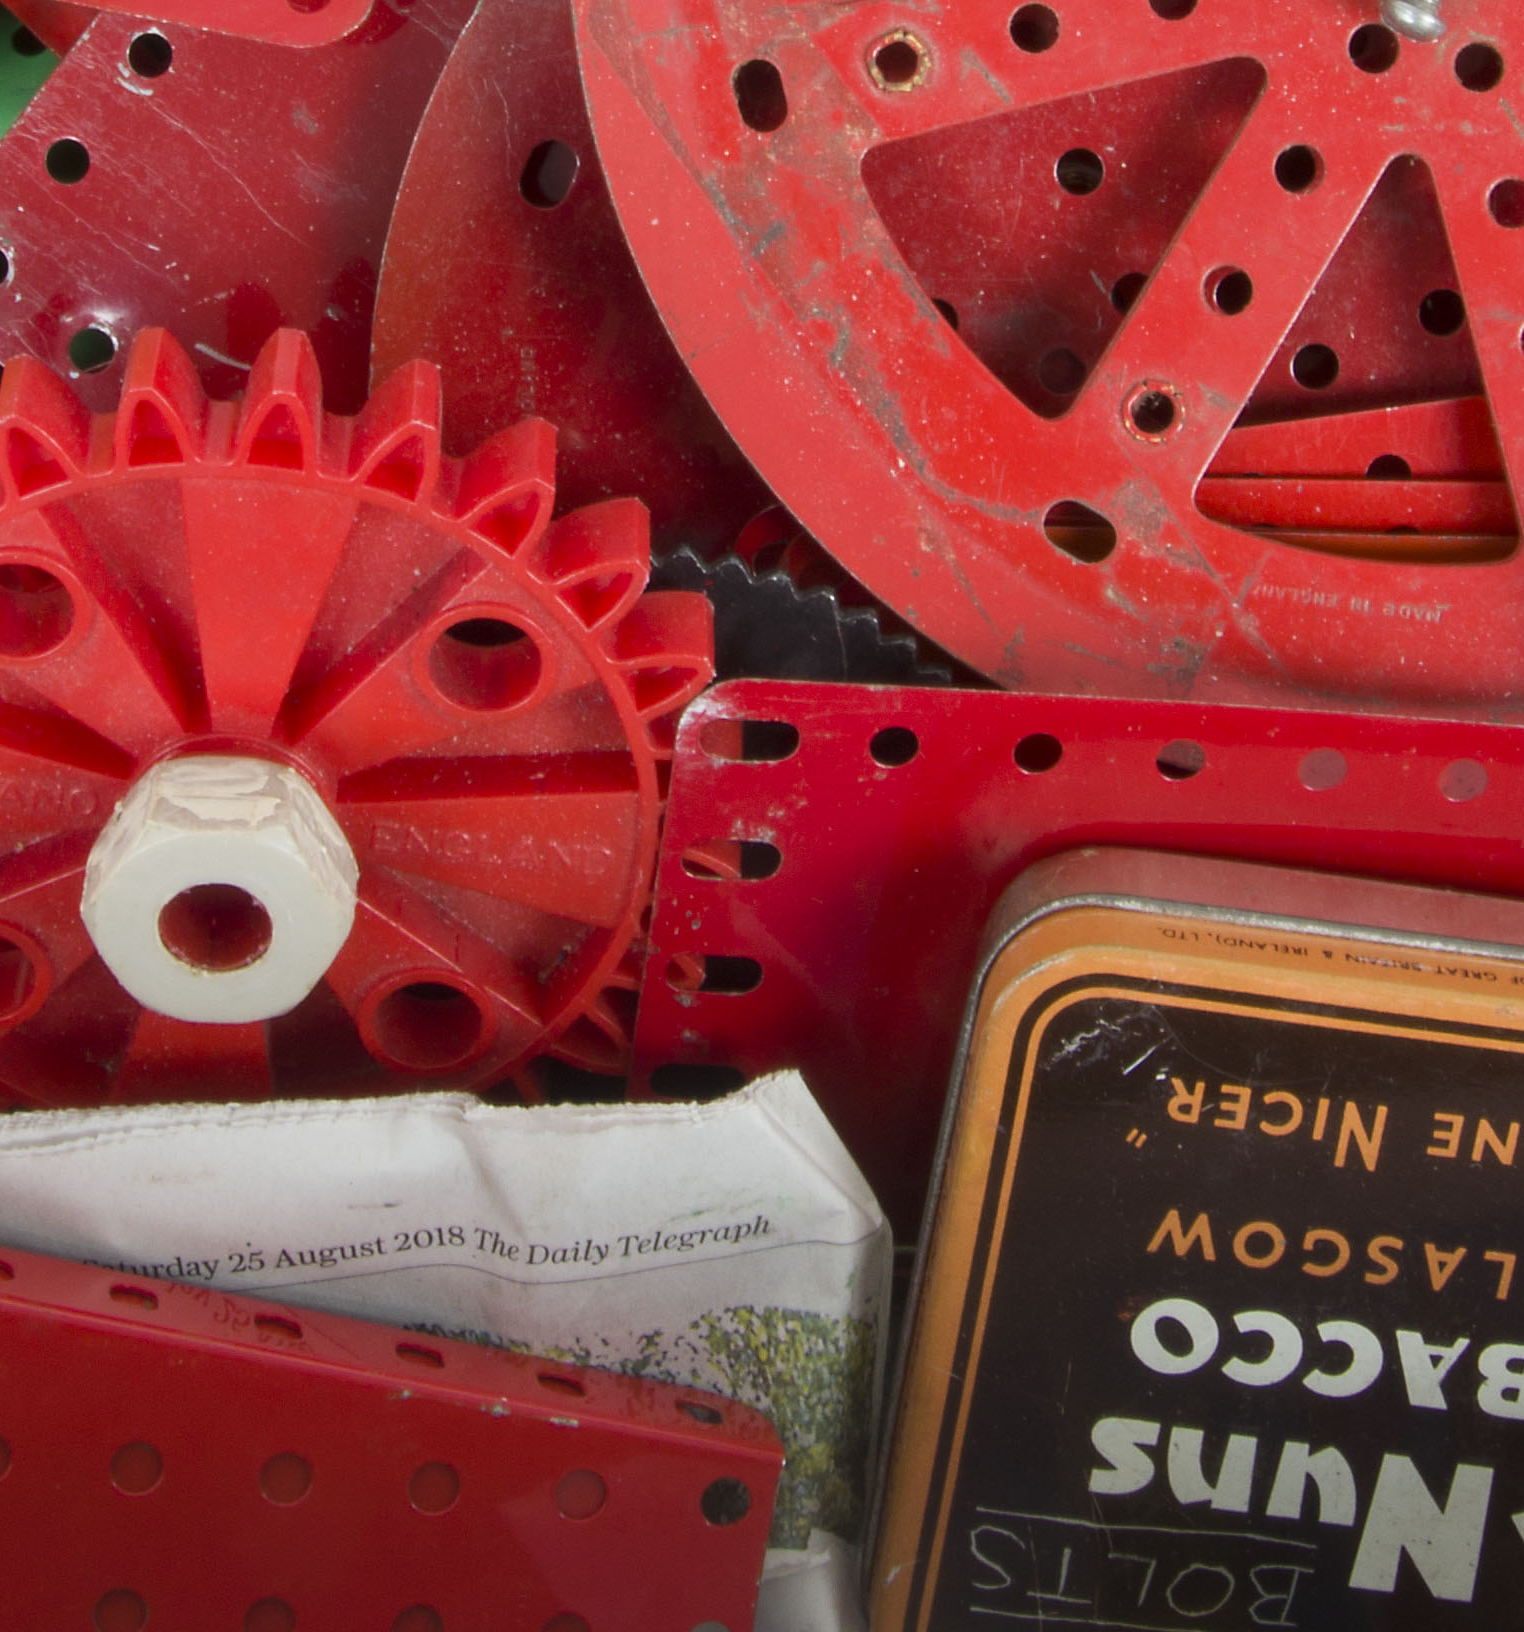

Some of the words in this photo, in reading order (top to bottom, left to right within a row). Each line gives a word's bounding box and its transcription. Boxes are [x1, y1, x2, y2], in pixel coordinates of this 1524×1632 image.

[1436, 964, 1498, 983] GREAT
[228, 1251, 265, 1273] 25
[275, 1232, 388, 1270] August
[393, 1223, 467, 1255] 2018
[474, 1226, 521, 1265] The
[527, 1233, 610, 1268] Daily
[617, 1214, 772, 1262] Telegraph
[1088, 1415, 1495, 1604] Nuns
[968, 1524, 1316, 1628] BOLTS
